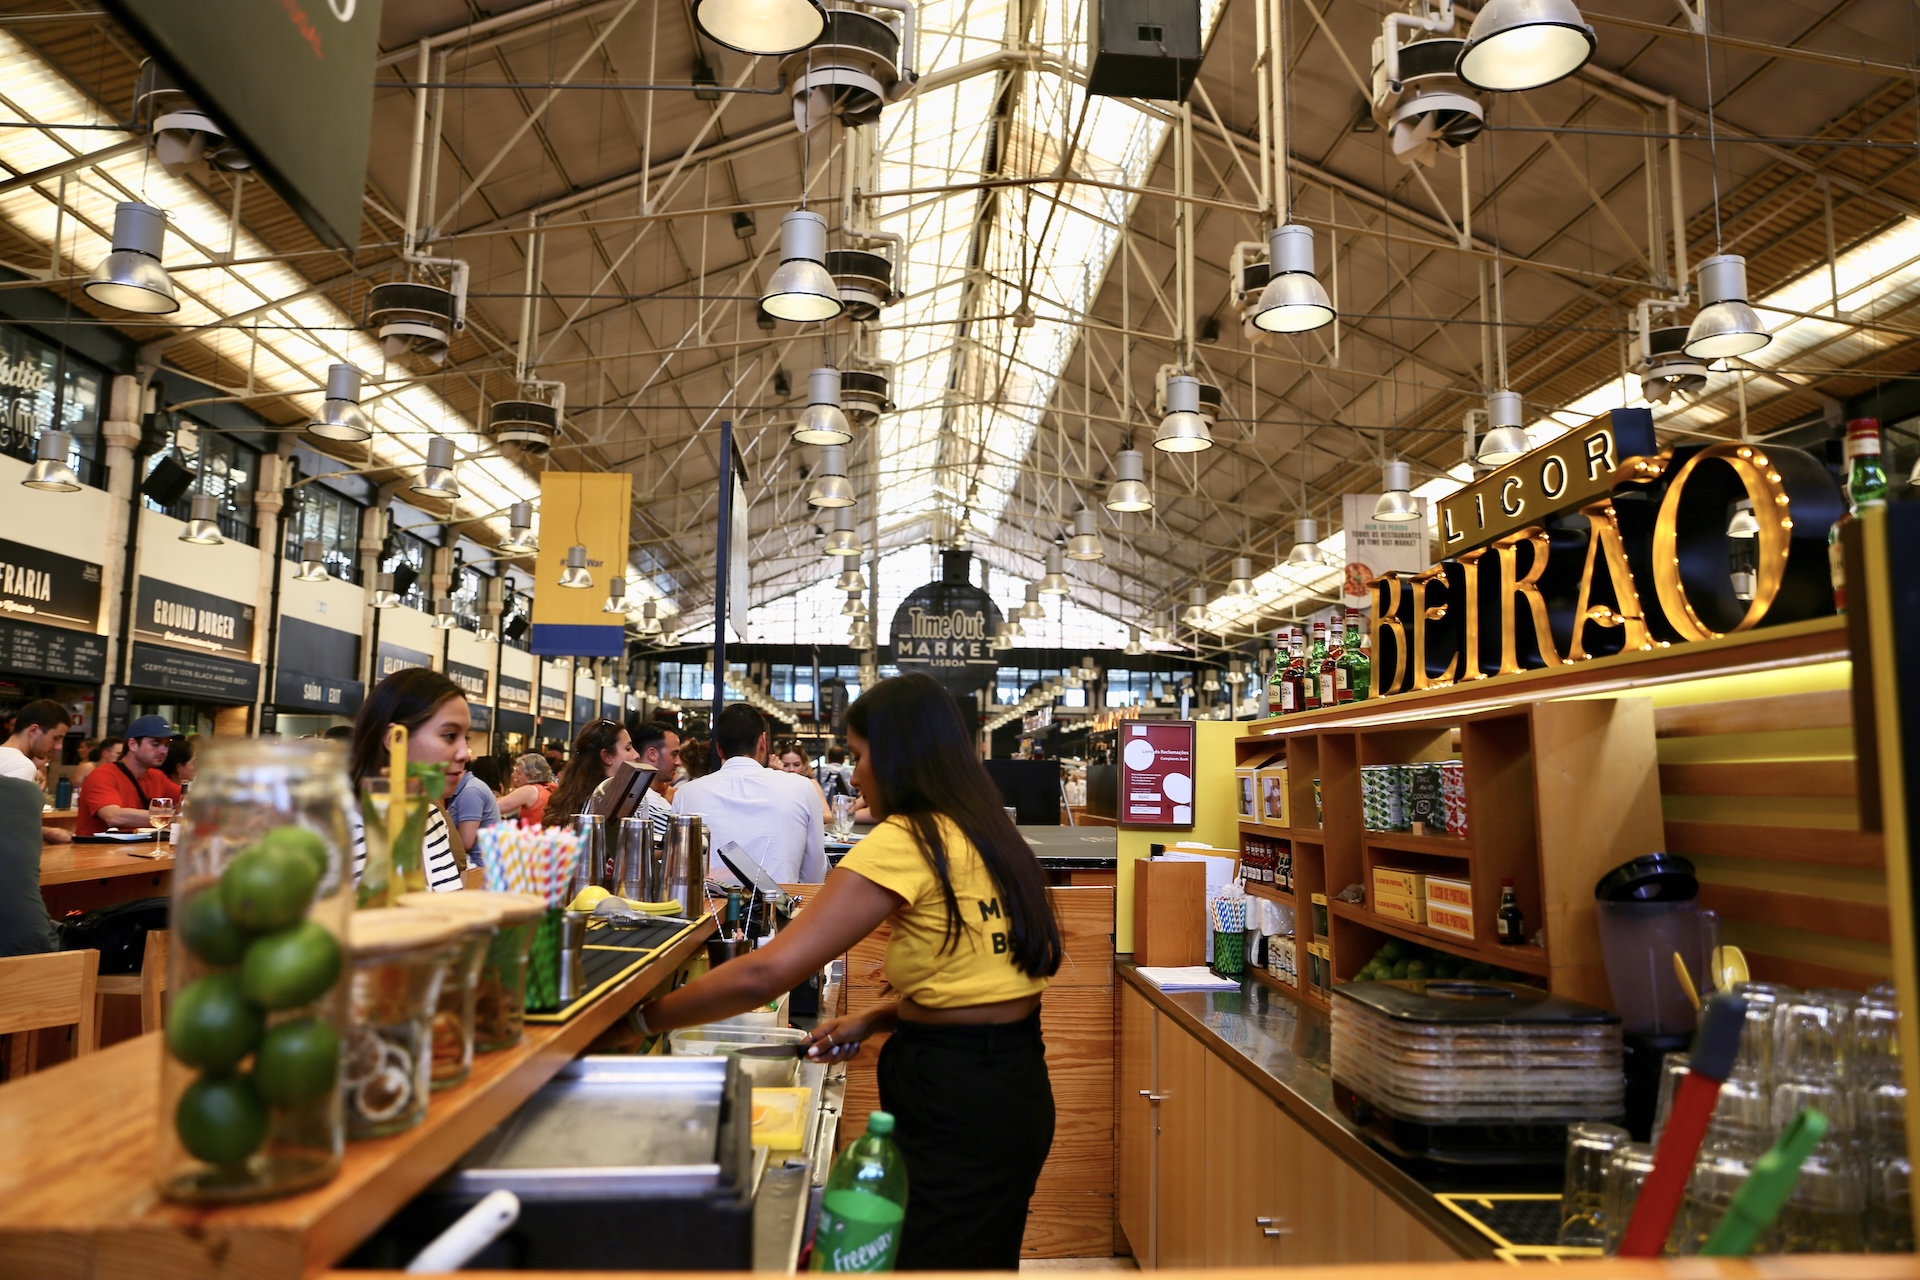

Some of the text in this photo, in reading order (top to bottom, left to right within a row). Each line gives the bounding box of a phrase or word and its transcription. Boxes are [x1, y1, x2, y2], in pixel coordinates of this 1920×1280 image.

[1444, 429, 1617, 544] LICOR
[1381, 531, 1421, 539] RESTAURANTES
[1366, 441, 1793, 699] BEIRÃO
[154, 599, 196, 631] GROUND
[198, 609, 235, 640] BURGER
[898, 641, 996, 658] MARKET
[930, 659, 965, 668] LISBOA
[194, 670, 213, 680] BLACK
[303, 681, 341, 704] SAÍDA EXIT
